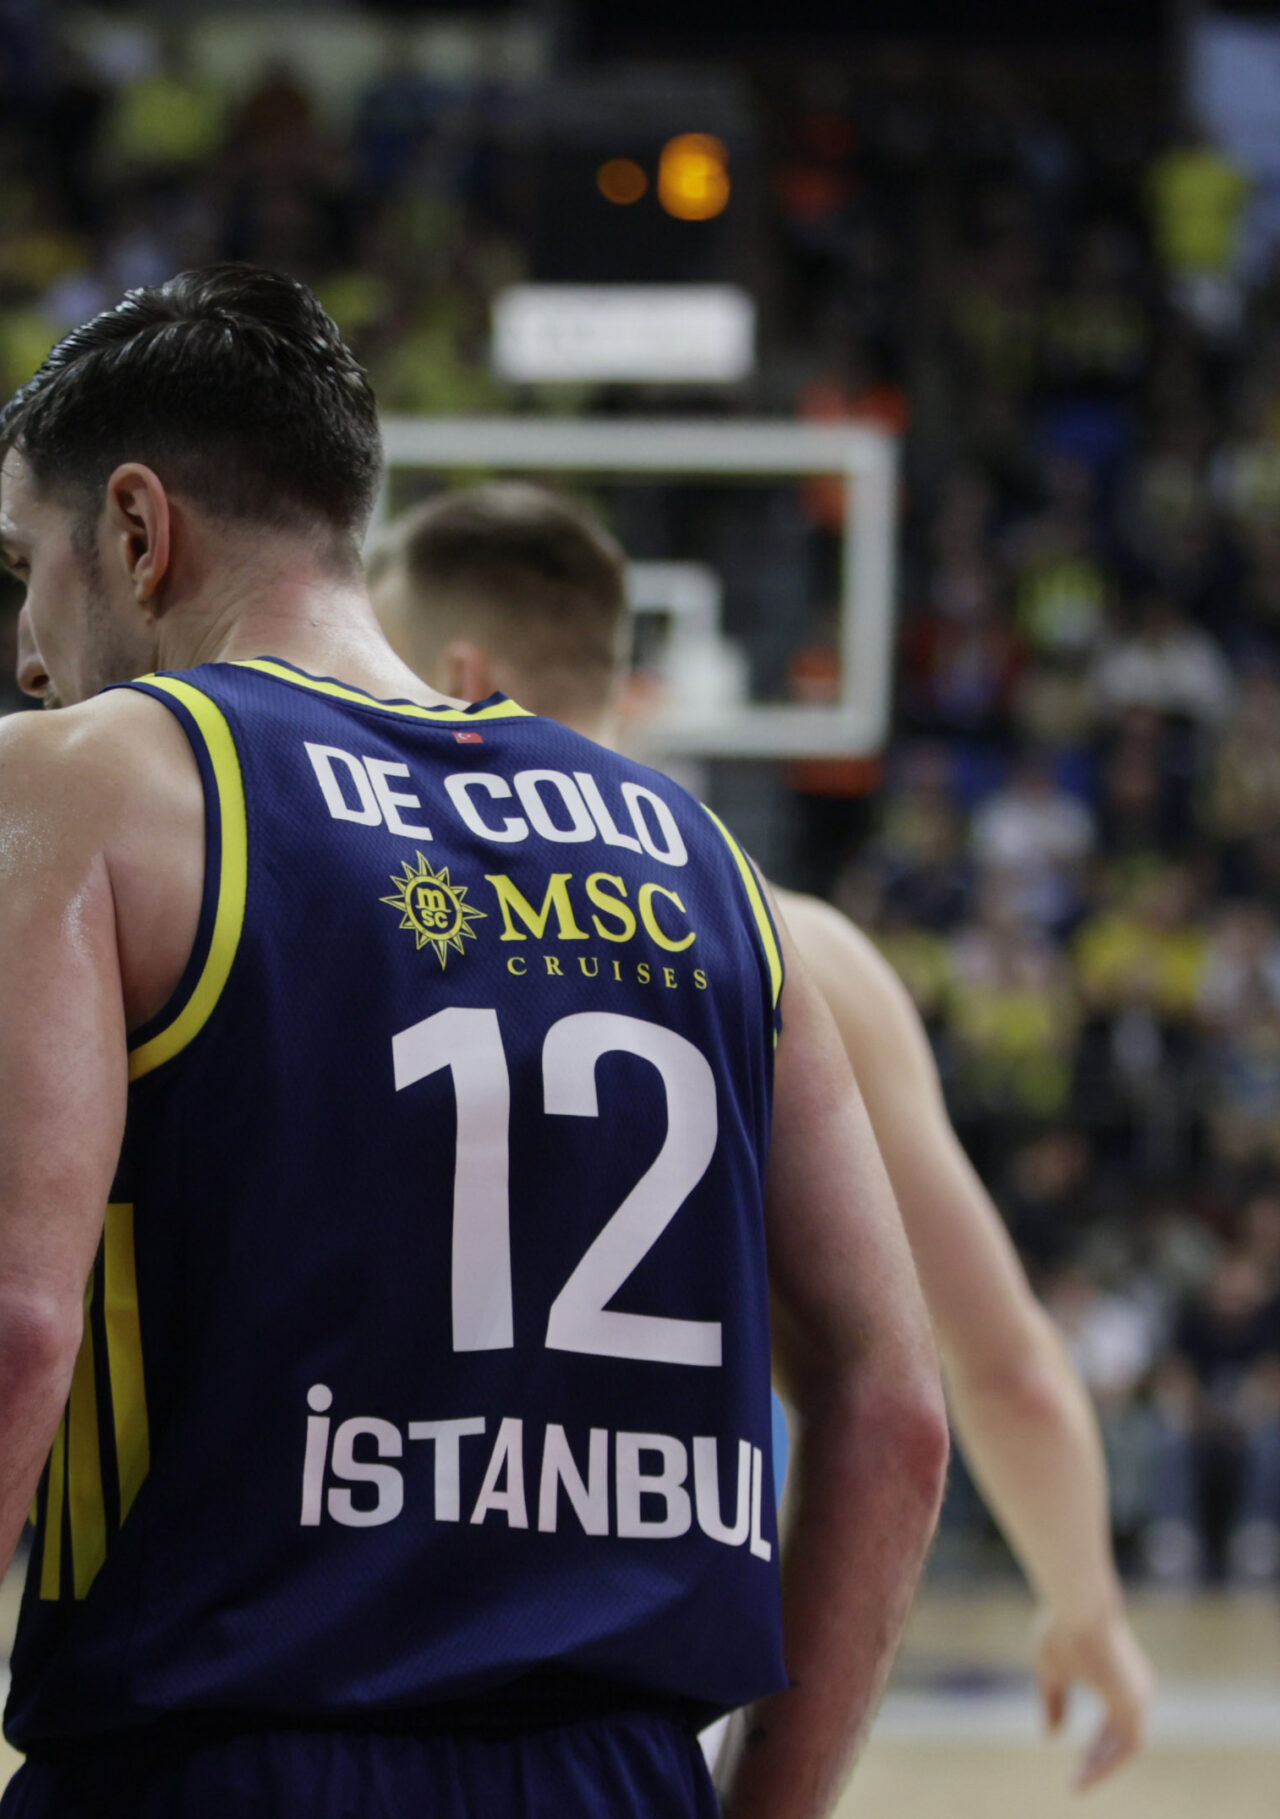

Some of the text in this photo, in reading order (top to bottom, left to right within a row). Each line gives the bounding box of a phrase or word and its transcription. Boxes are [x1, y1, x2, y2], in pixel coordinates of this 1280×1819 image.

[303, 741, 688, 867] DE COLO
[484, 872, 696, 952] MSC
[507, 955, 707, 990] CRUISES
[392, 1007, 722, 1366] 12
